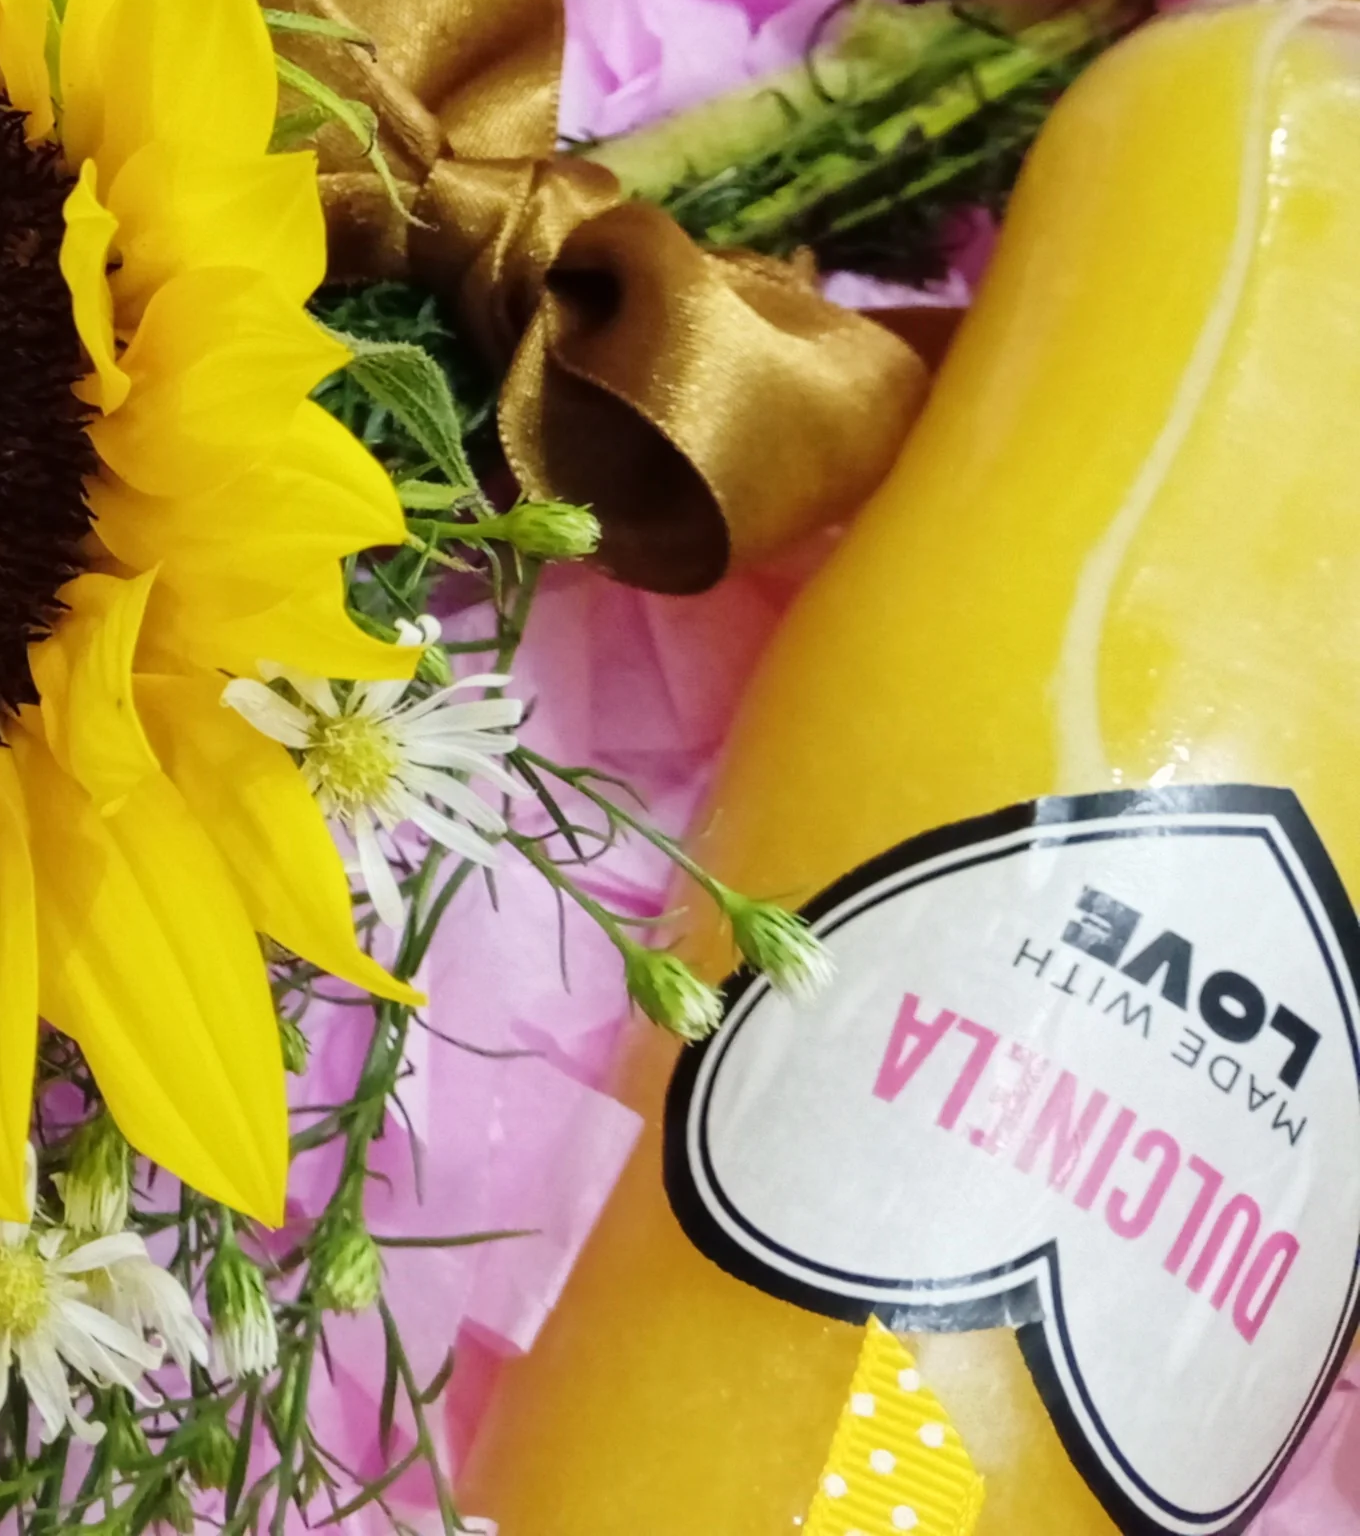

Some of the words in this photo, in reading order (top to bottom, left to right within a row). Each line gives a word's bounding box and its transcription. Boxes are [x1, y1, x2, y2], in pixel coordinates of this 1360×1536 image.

[1011, 936, 1154, 1039] WITH
[1060, 885, 1322, 1091] LOVE
[871, 992, 1302, 1346] DULCINELA
[1171, 1033, 1309, 1148] MADE
